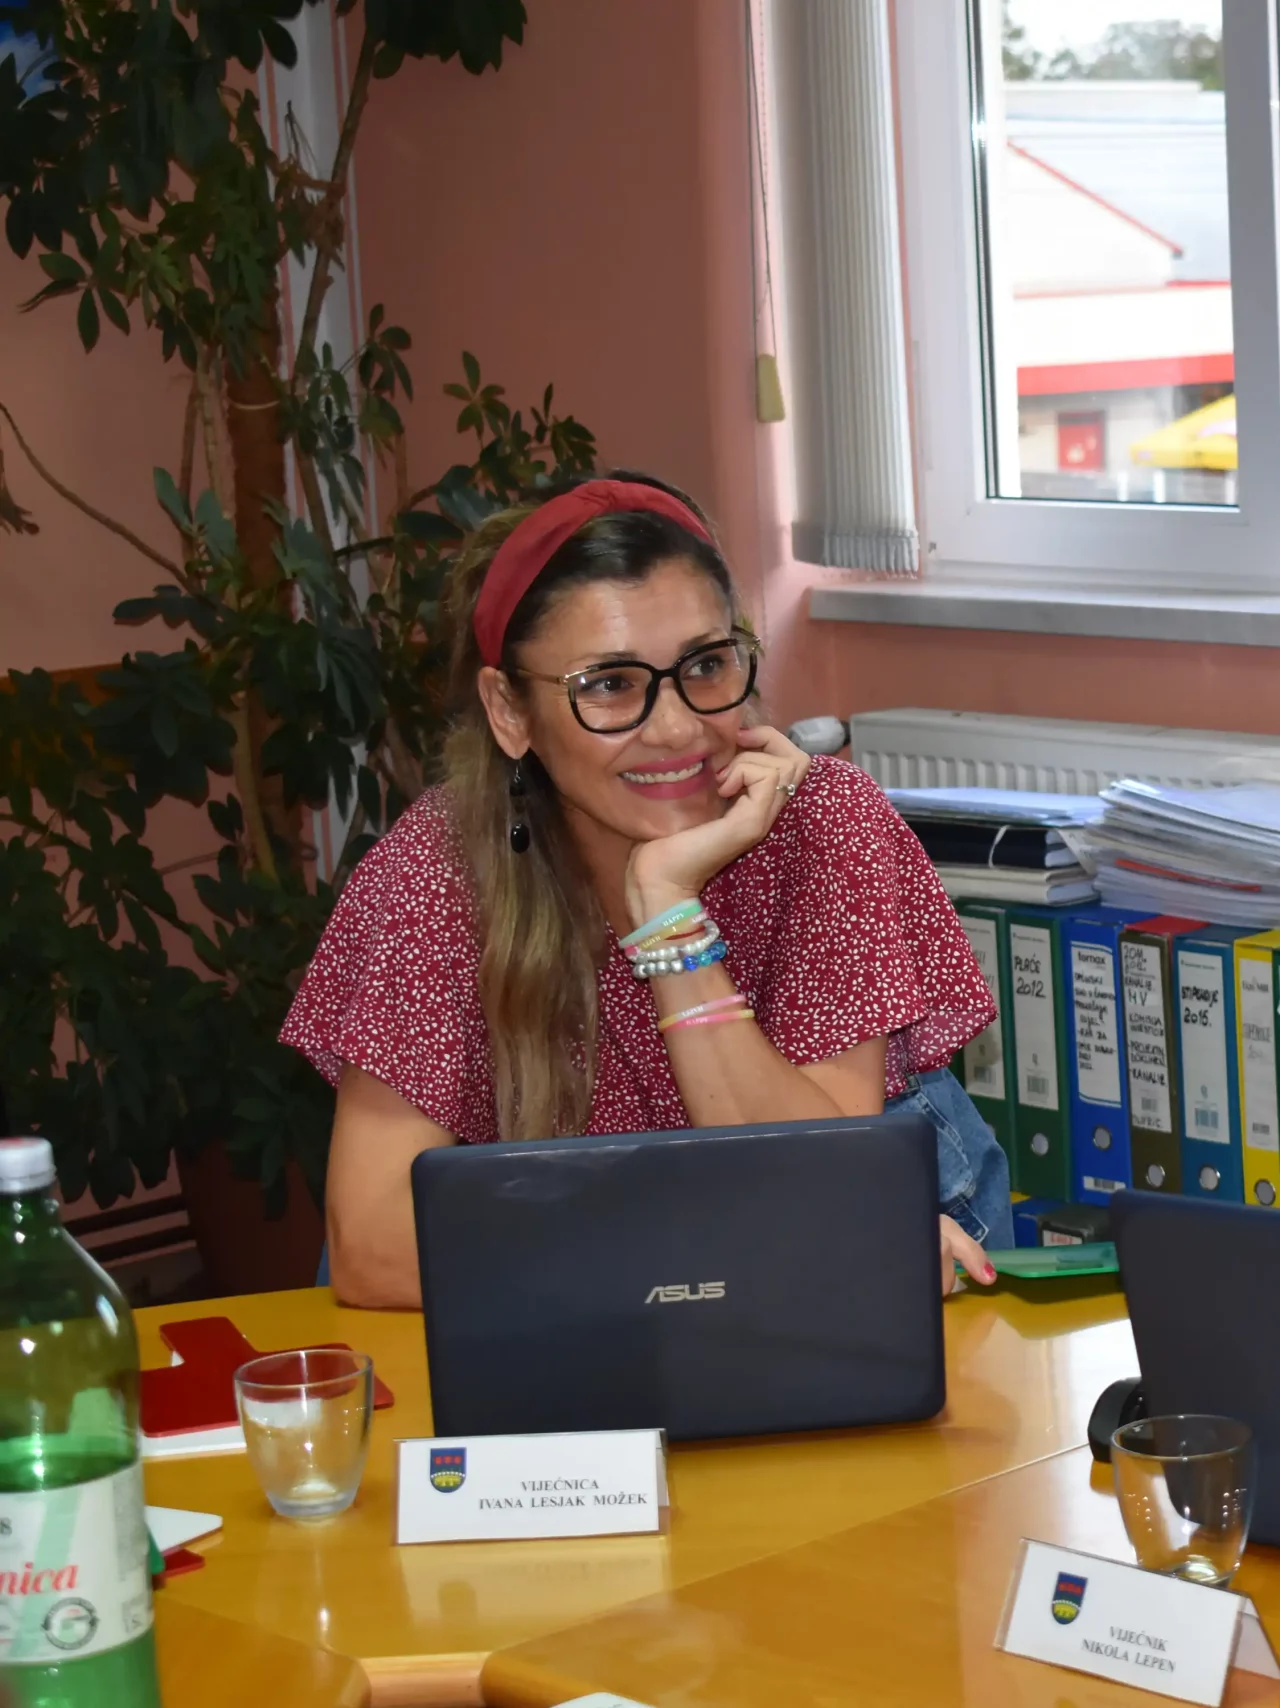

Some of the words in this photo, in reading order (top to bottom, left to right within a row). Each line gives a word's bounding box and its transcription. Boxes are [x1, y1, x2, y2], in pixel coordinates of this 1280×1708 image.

[644, 1281, 725, 1304] ASUS
[479, 1498, 524, 1510] IVANA
[530, 1495, 586, 1508] LESJAK
[592, 1492, 648, 1506] MOŽEK
[1081, 1638, 1130, 1662] NIKOLA
[1134, 1651, 1177, 1674] LEPEN
